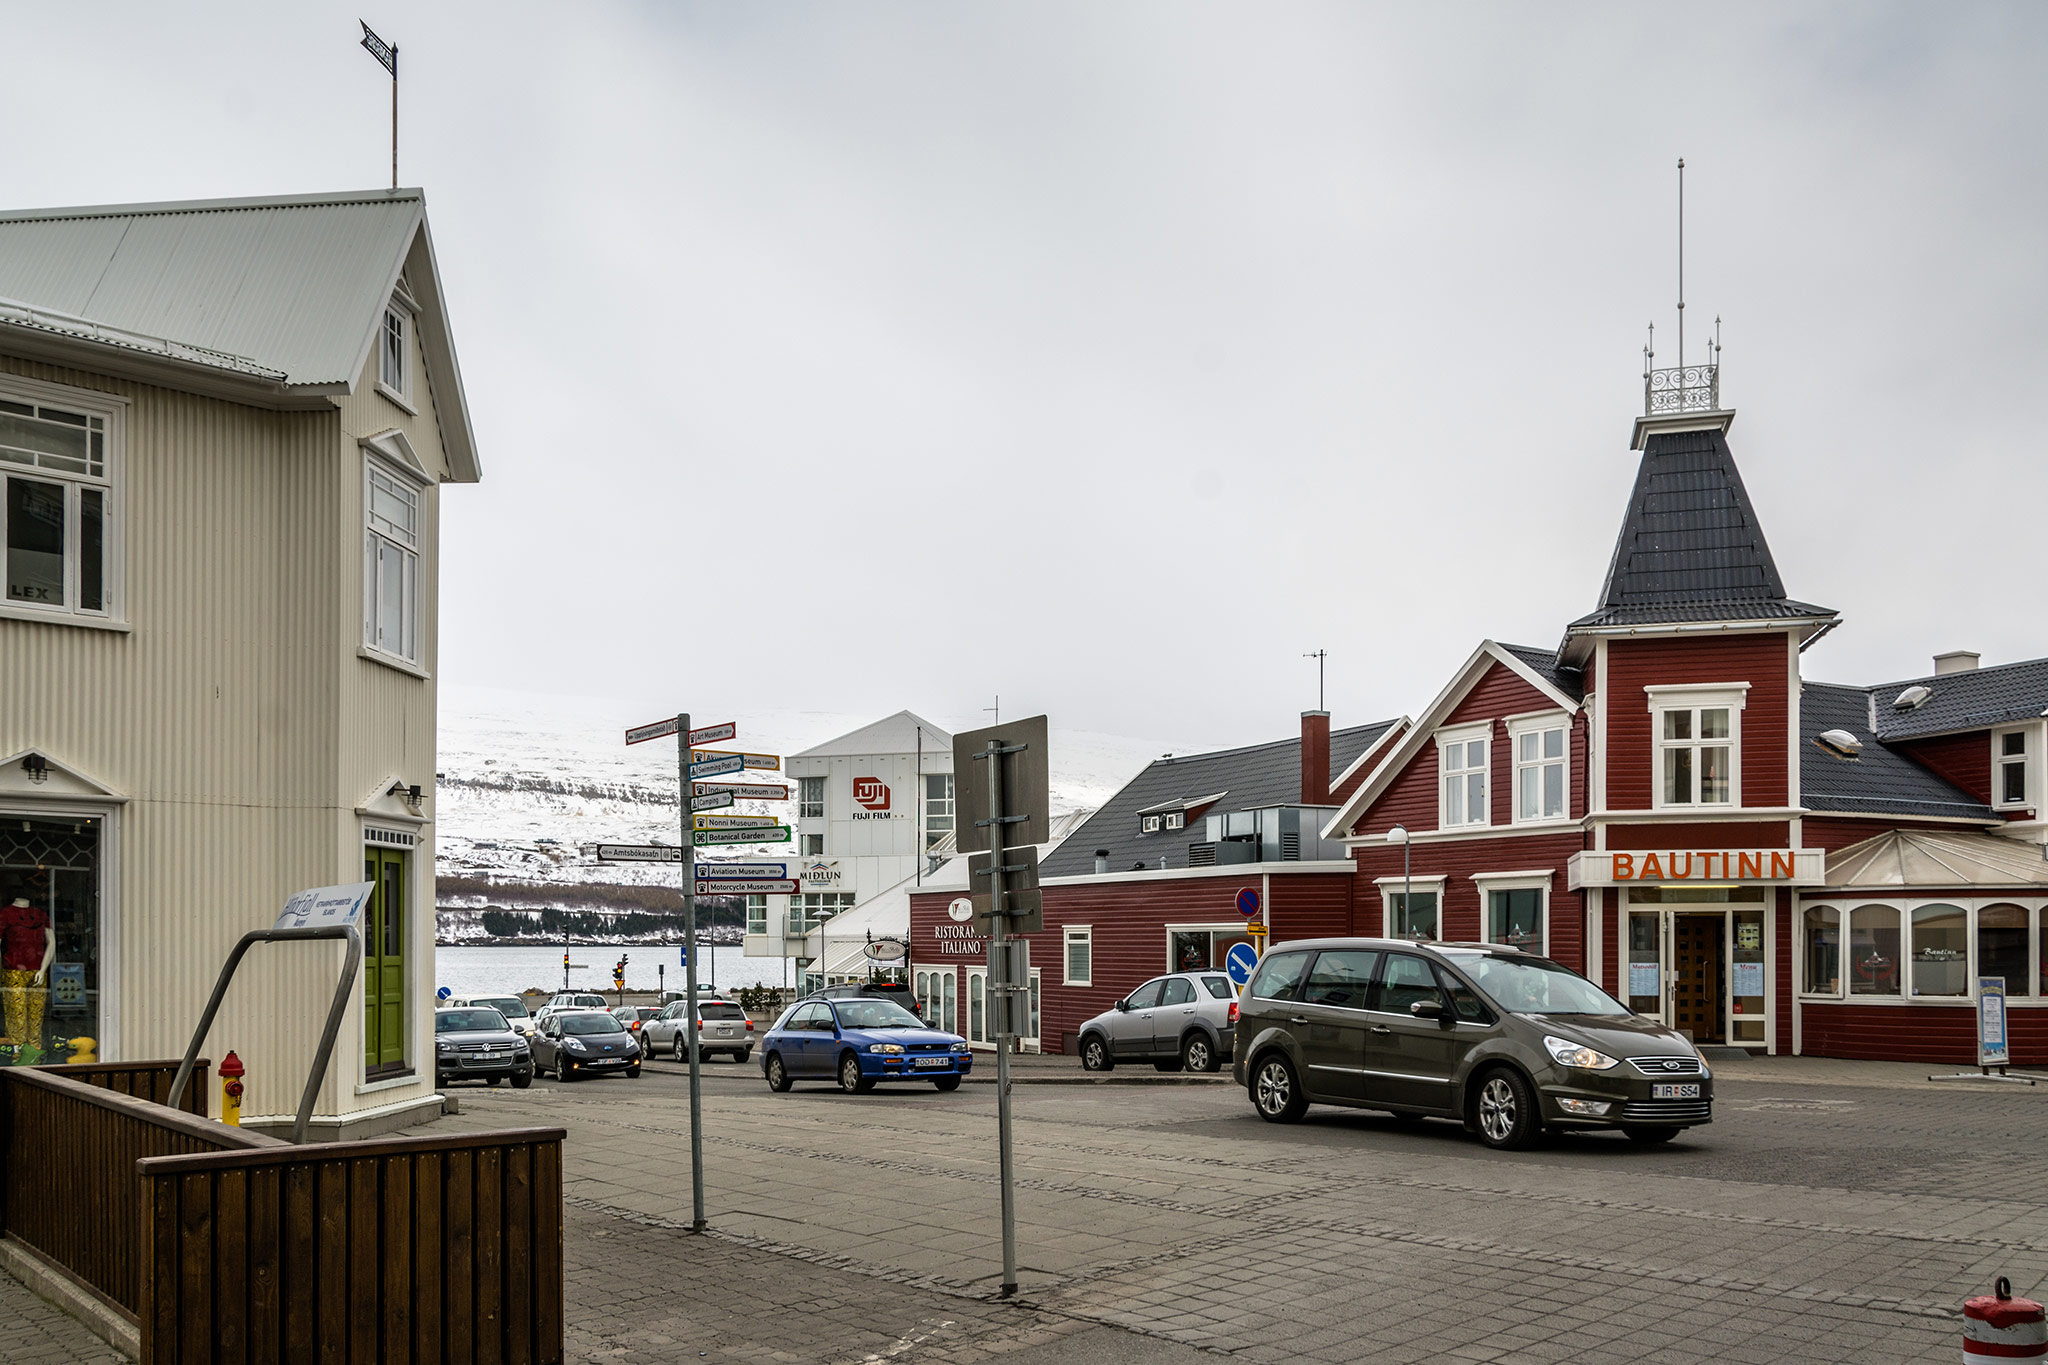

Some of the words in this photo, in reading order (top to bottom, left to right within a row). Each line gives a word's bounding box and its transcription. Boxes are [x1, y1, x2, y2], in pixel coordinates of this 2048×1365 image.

[11, 584, 49, 600] LEX
[704, 729, 723, 739] Museum
[698, 764, 721, 774] Swimming
[722, 761, 732, 769] Pool
[700, 797, 718, 806] Camping
[852, 812, 870, 820] FUJI
[872, 812, 891, 820] FILM
[730, 819, 758, 827] Museum
[709, 833, 740, 841] Botanical
[741, 832, 766, 840] Garden
[1612, 851, 1795, 880] BAUTINN
[710, 867, 737, 875] Aviation
[710, 883, 745, 891] Motorcycle
[935, 925, 988, 939] RISTORAN
[941, 940, 981, 954] ITALIANO
[1922, 947, 1957, 956] Bautinn
[1662, 1086, 1673, 1096] IR
[1680, 1085, 1698, 1096] S54
